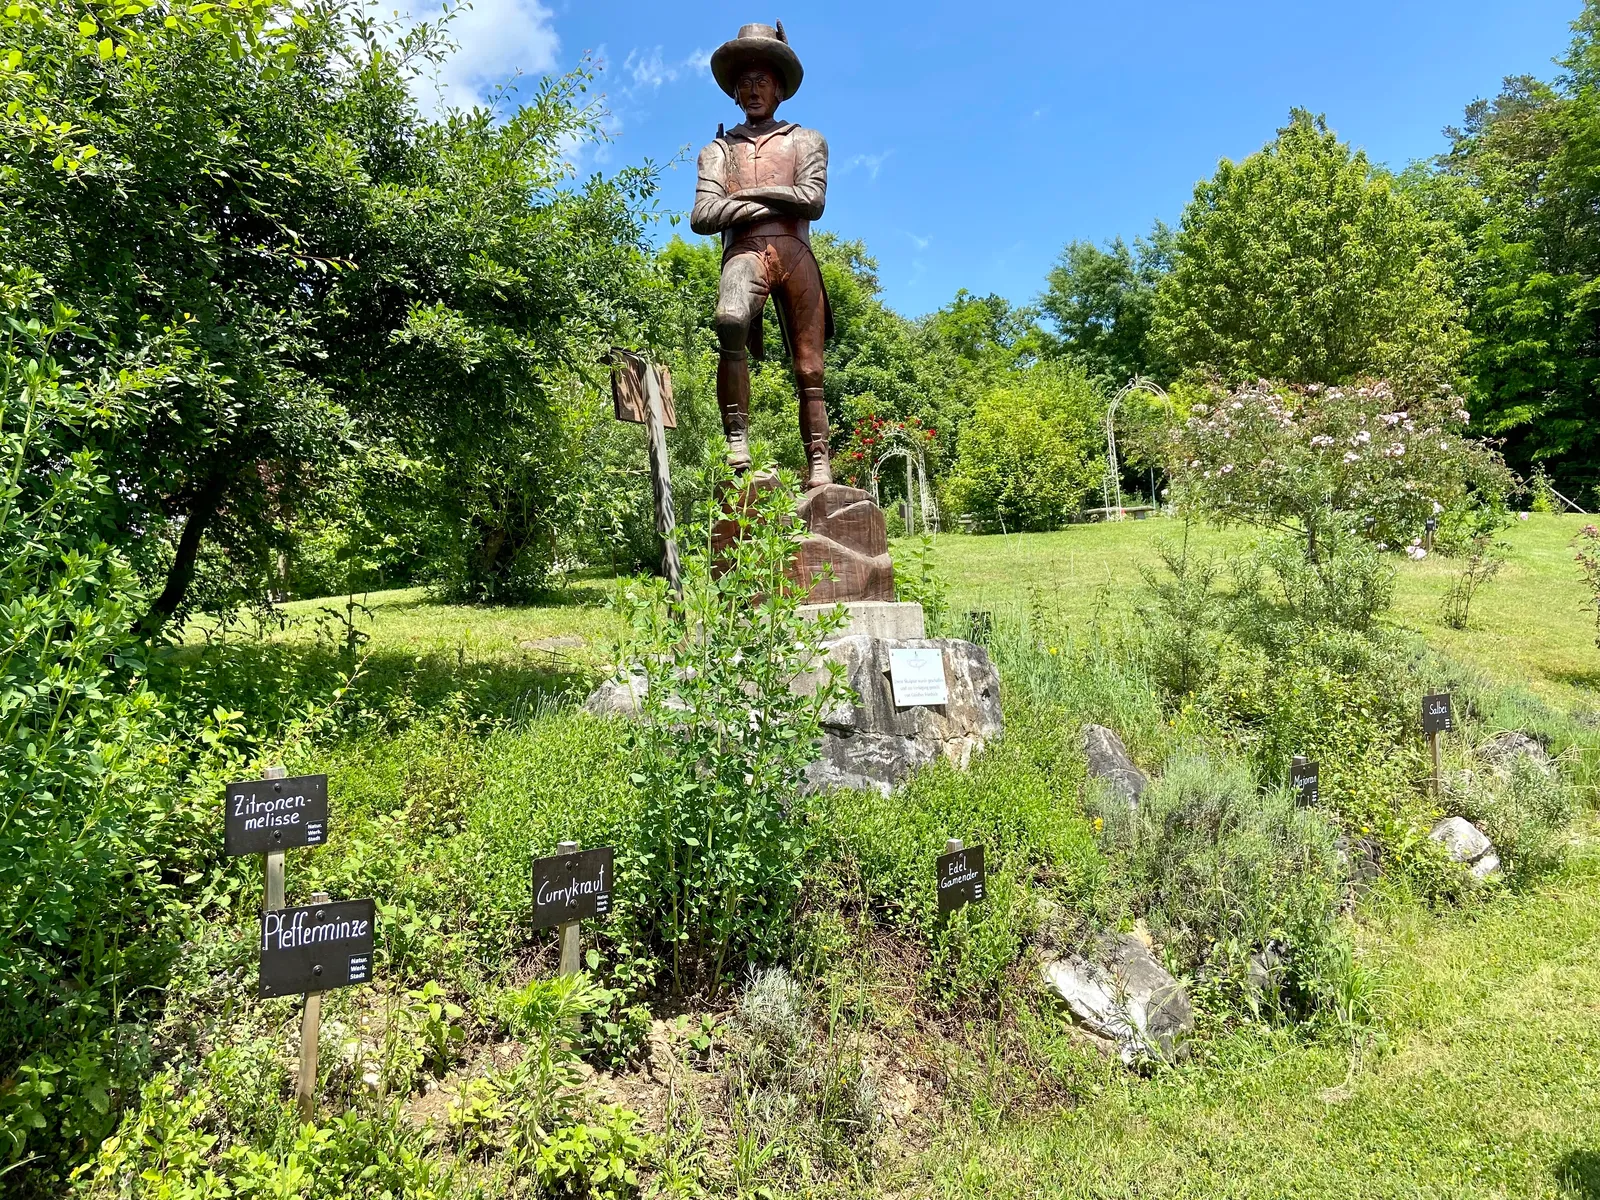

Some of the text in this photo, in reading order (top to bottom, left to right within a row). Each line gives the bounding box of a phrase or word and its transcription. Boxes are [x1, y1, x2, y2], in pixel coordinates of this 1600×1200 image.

[1428, 700, 1448, 715] Salbei
[1293, 774, 1317, 791] Majoran
[233, 793, 312, 817] Zitronen-
[244, 812, 300, 831] melisse
[948, 855, 967, 876] Edel
[536, 863, 605, 907] Currykraut
[940, 868, 979, 889] Gamender
[261, 911, 368, 951] Pfefferminze
